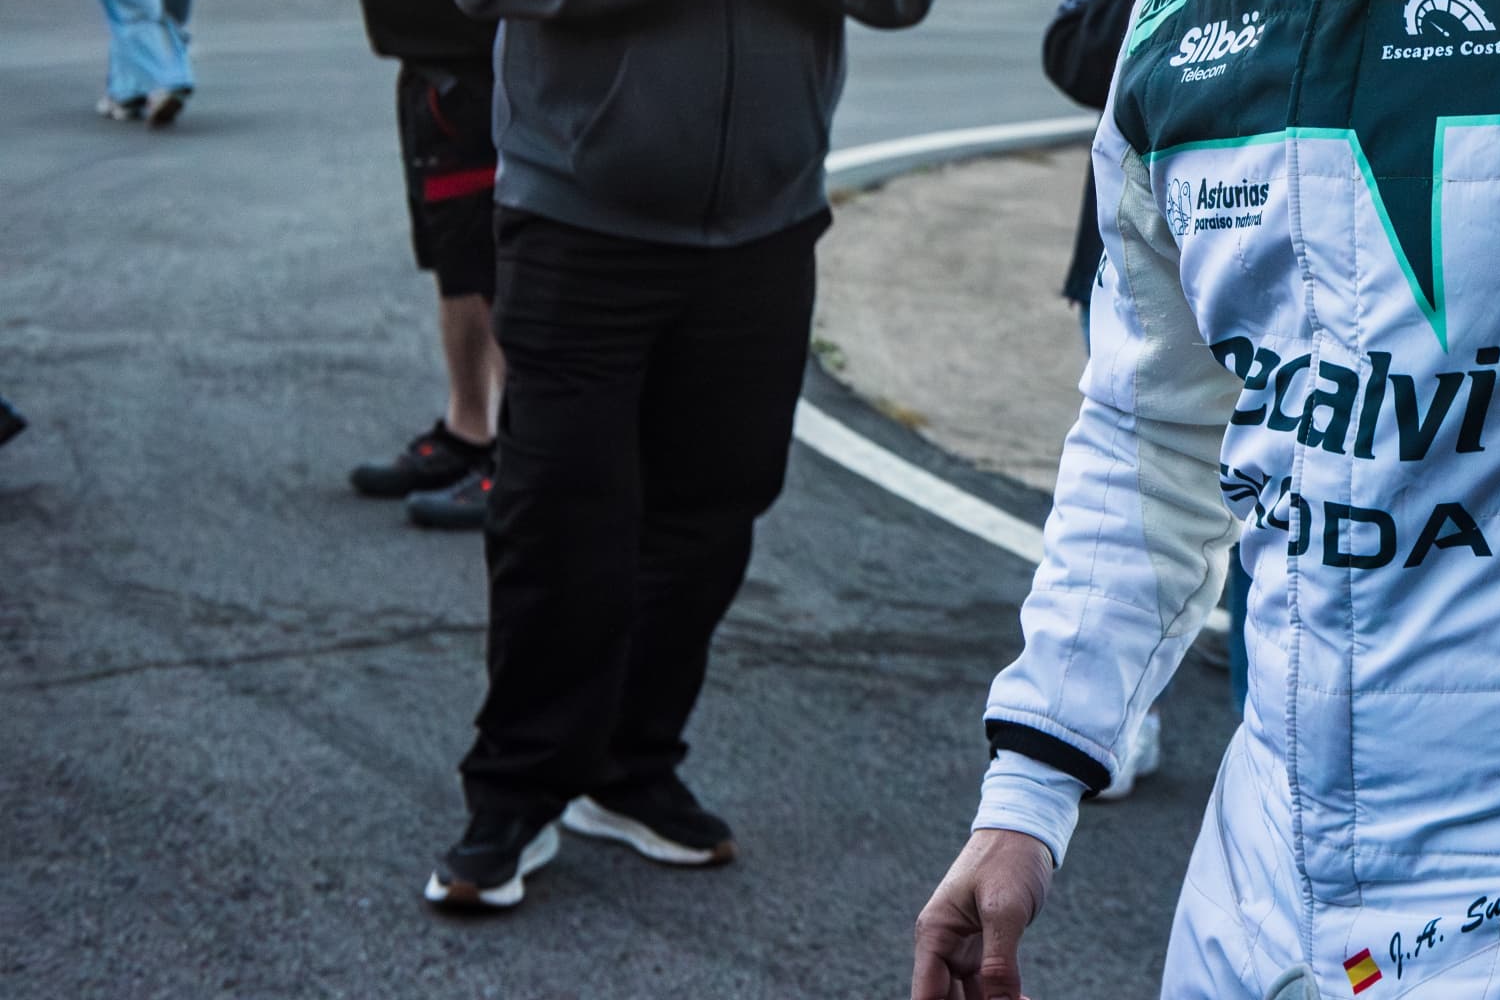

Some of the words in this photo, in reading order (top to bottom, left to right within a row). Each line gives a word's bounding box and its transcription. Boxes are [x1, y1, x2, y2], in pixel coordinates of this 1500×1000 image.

[1381, 45, 1454, 60] Escapes
[1181, 63, 1227, 83] Telecom
[1197, 178, 1270, 210] Asturias
[1235, 210, 1263, 229] natural
